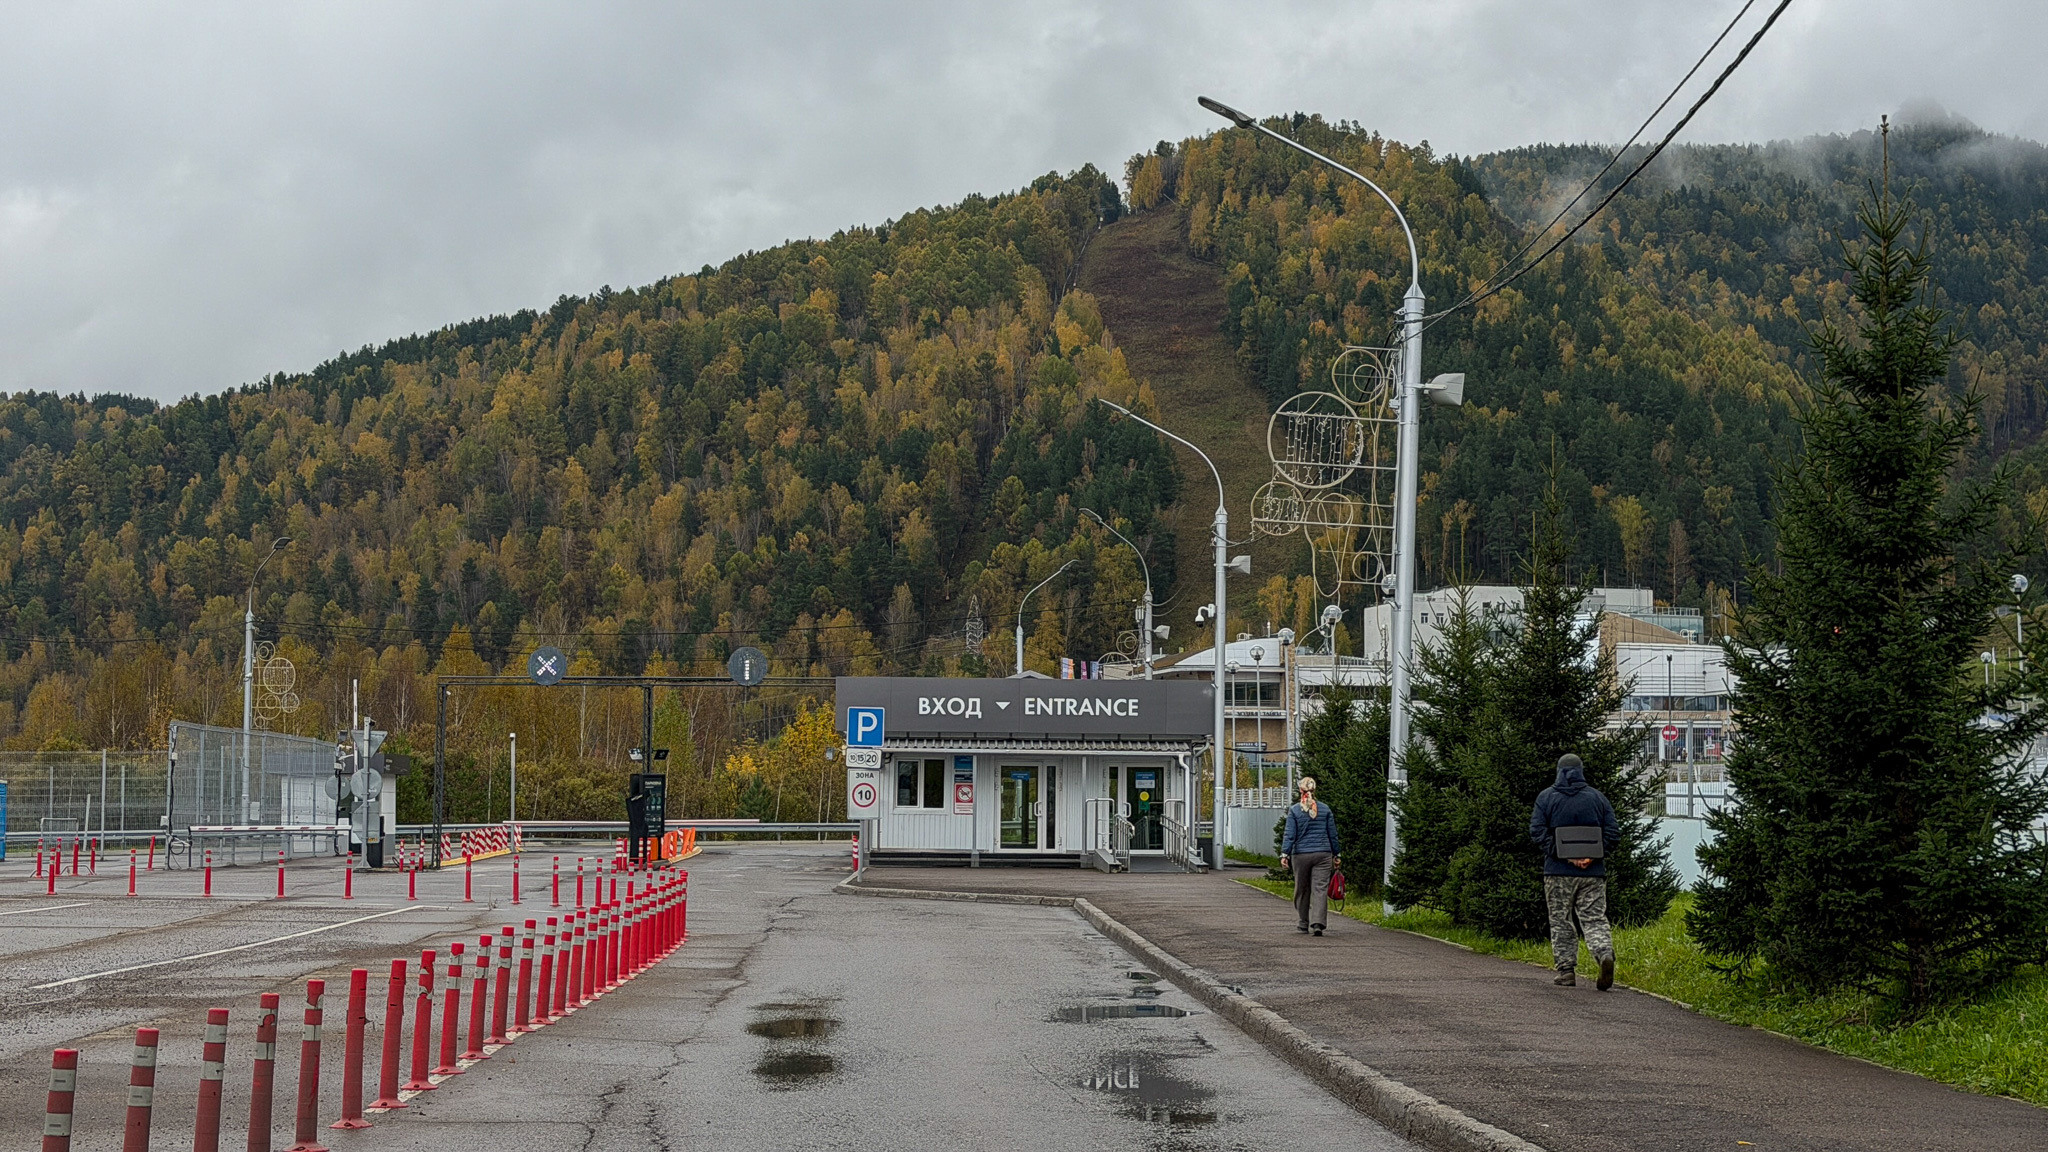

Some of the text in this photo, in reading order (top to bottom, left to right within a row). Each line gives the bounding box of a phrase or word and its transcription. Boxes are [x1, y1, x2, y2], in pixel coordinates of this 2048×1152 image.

[918, 697, 982, 719] ВХОД
[1024, 697, 1139, 717] ENTRANCE
[857, 711, 878, 742] P
[857, 754, 864, 762] 15
[866, 754, 877, 763] 20
[857, 789, 872, 801] 10
